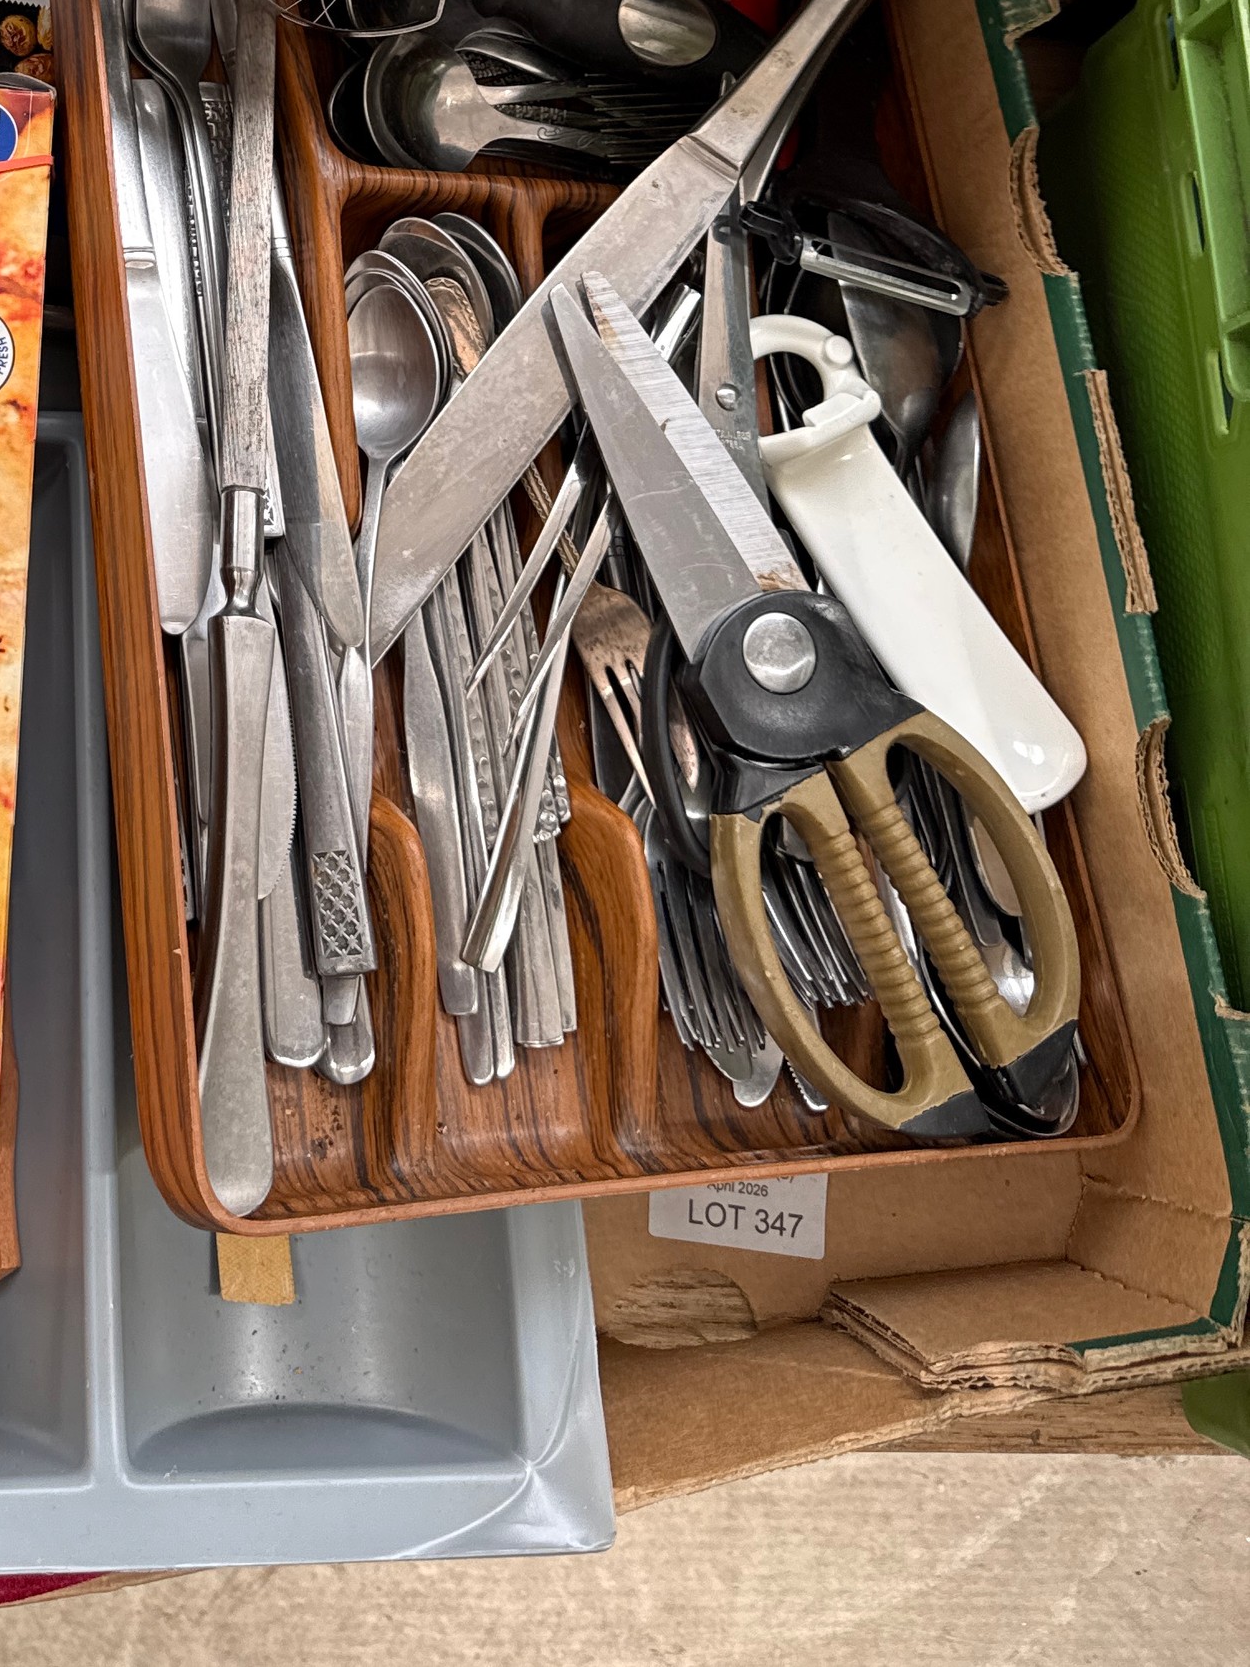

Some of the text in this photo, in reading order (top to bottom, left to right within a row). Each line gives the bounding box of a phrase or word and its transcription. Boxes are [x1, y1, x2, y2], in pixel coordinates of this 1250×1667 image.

[738, 1181, 769, 1197] 2026
[688, 1198, 804, 1238] LOT 347
